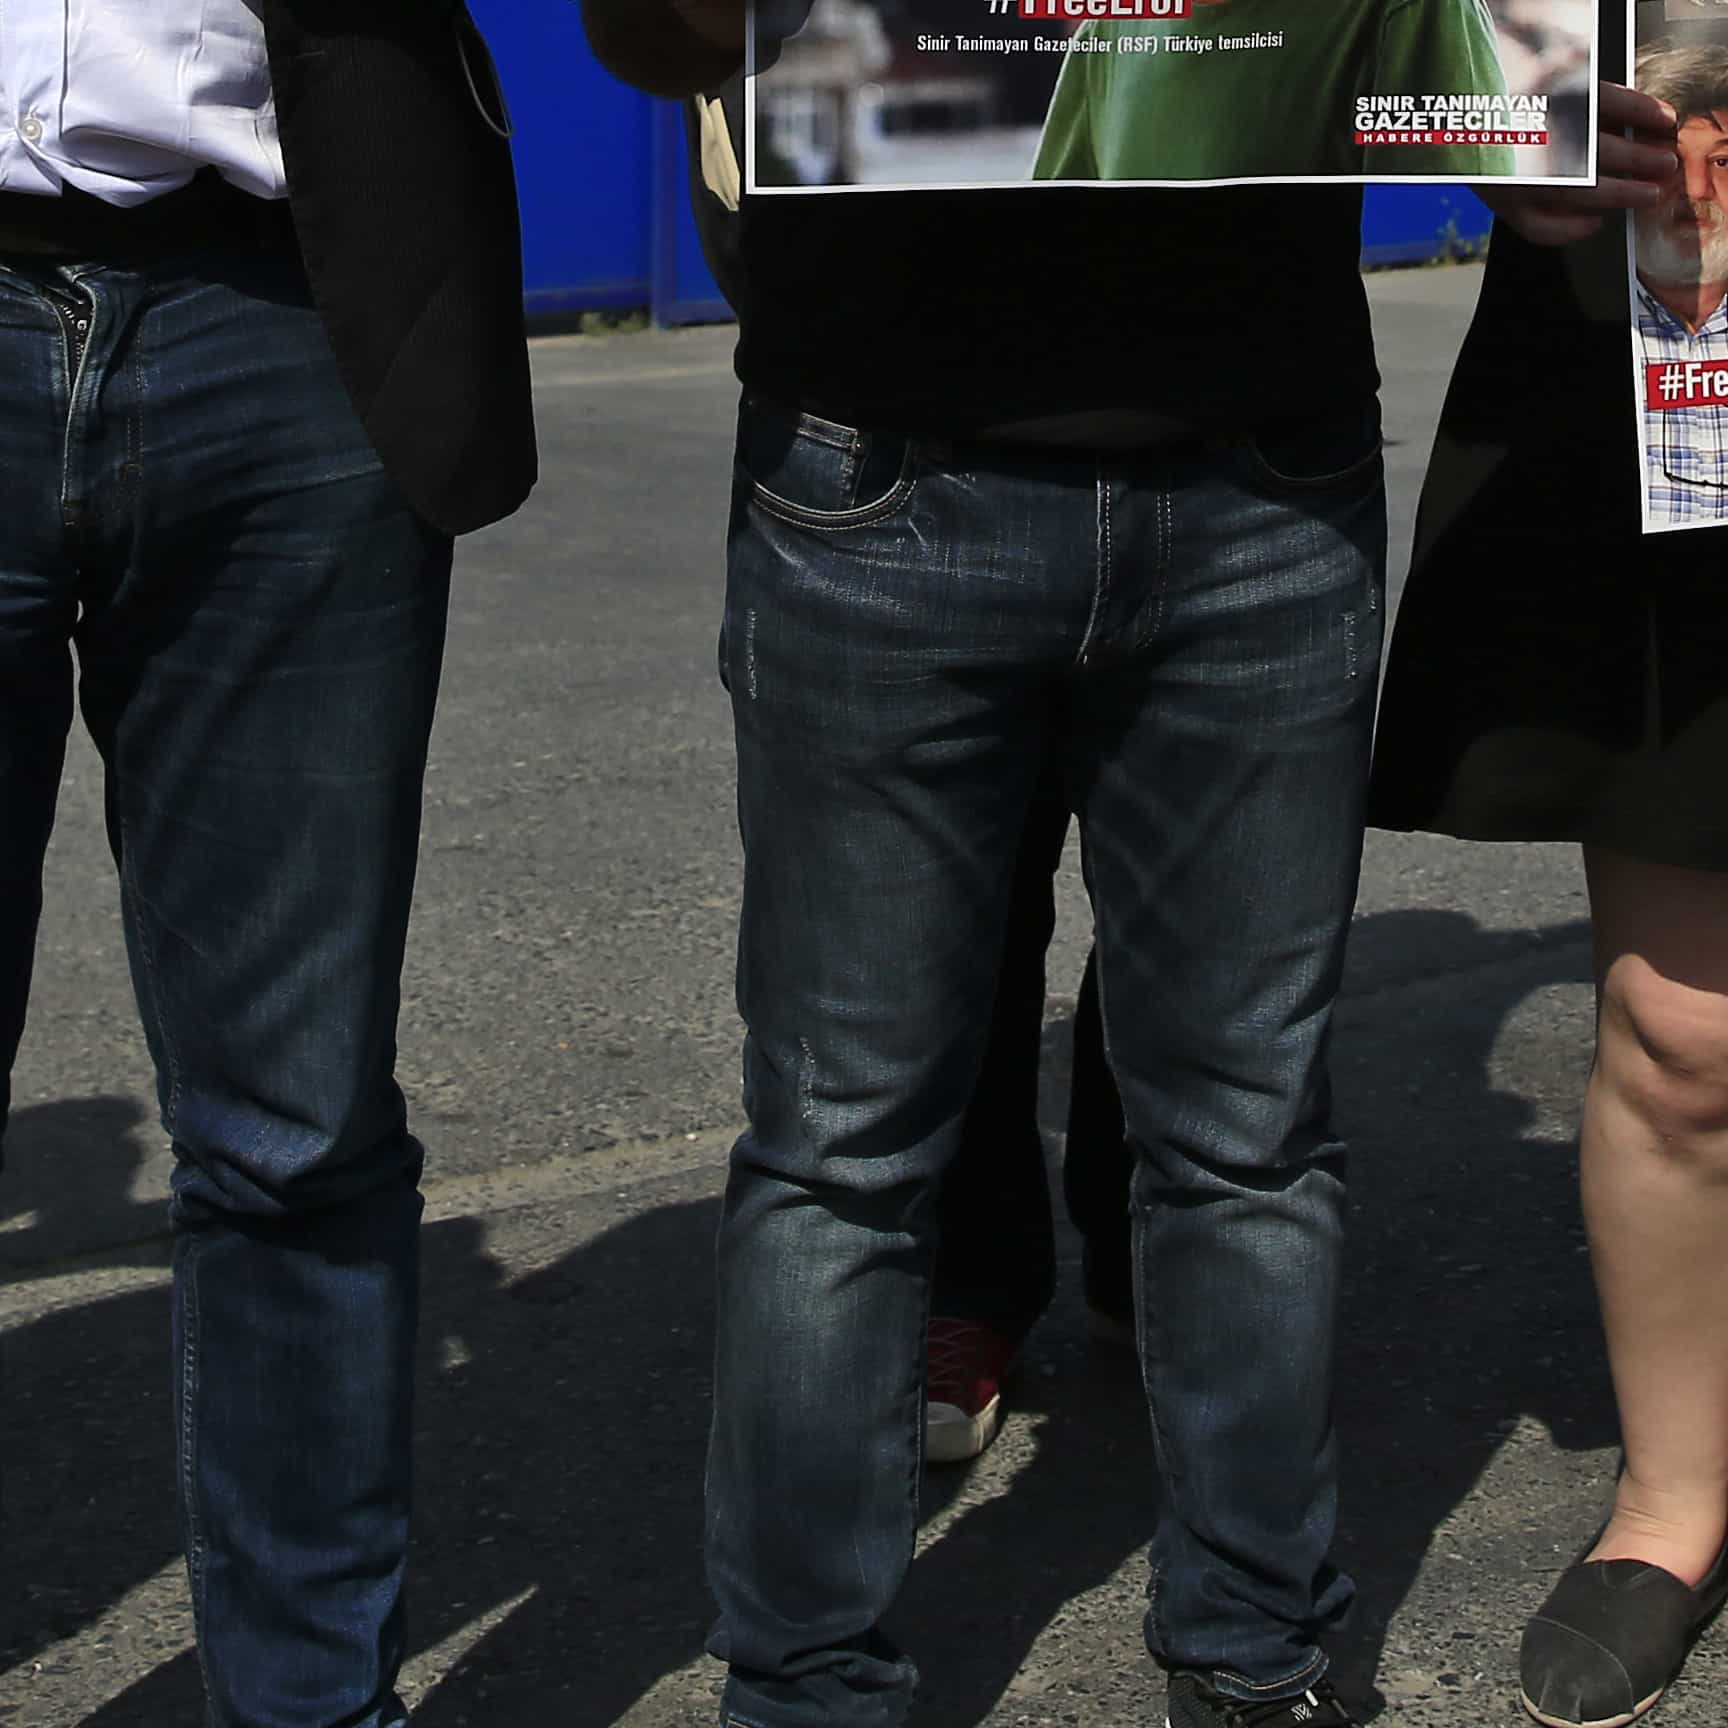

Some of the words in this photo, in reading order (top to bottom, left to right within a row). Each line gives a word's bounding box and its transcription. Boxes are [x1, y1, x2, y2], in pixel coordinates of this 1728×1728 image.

[917, 35, 951, 51] Sinir
[955, 35, 1029, 53] Tanimayan
[1034, 37, 1112, 52] Gazeteciler
[1117, 36, 1158, 54] (RSF)
[1164, 36, 1213, 54] Türkiye
[1218, 31, 1284, 50] temsilcisi
[1355, 96, 1415, 112] SINIR
[1421, 95, 1548, 112] TANIMAYAN
[1363, 133, 1433, 143] HABERE
